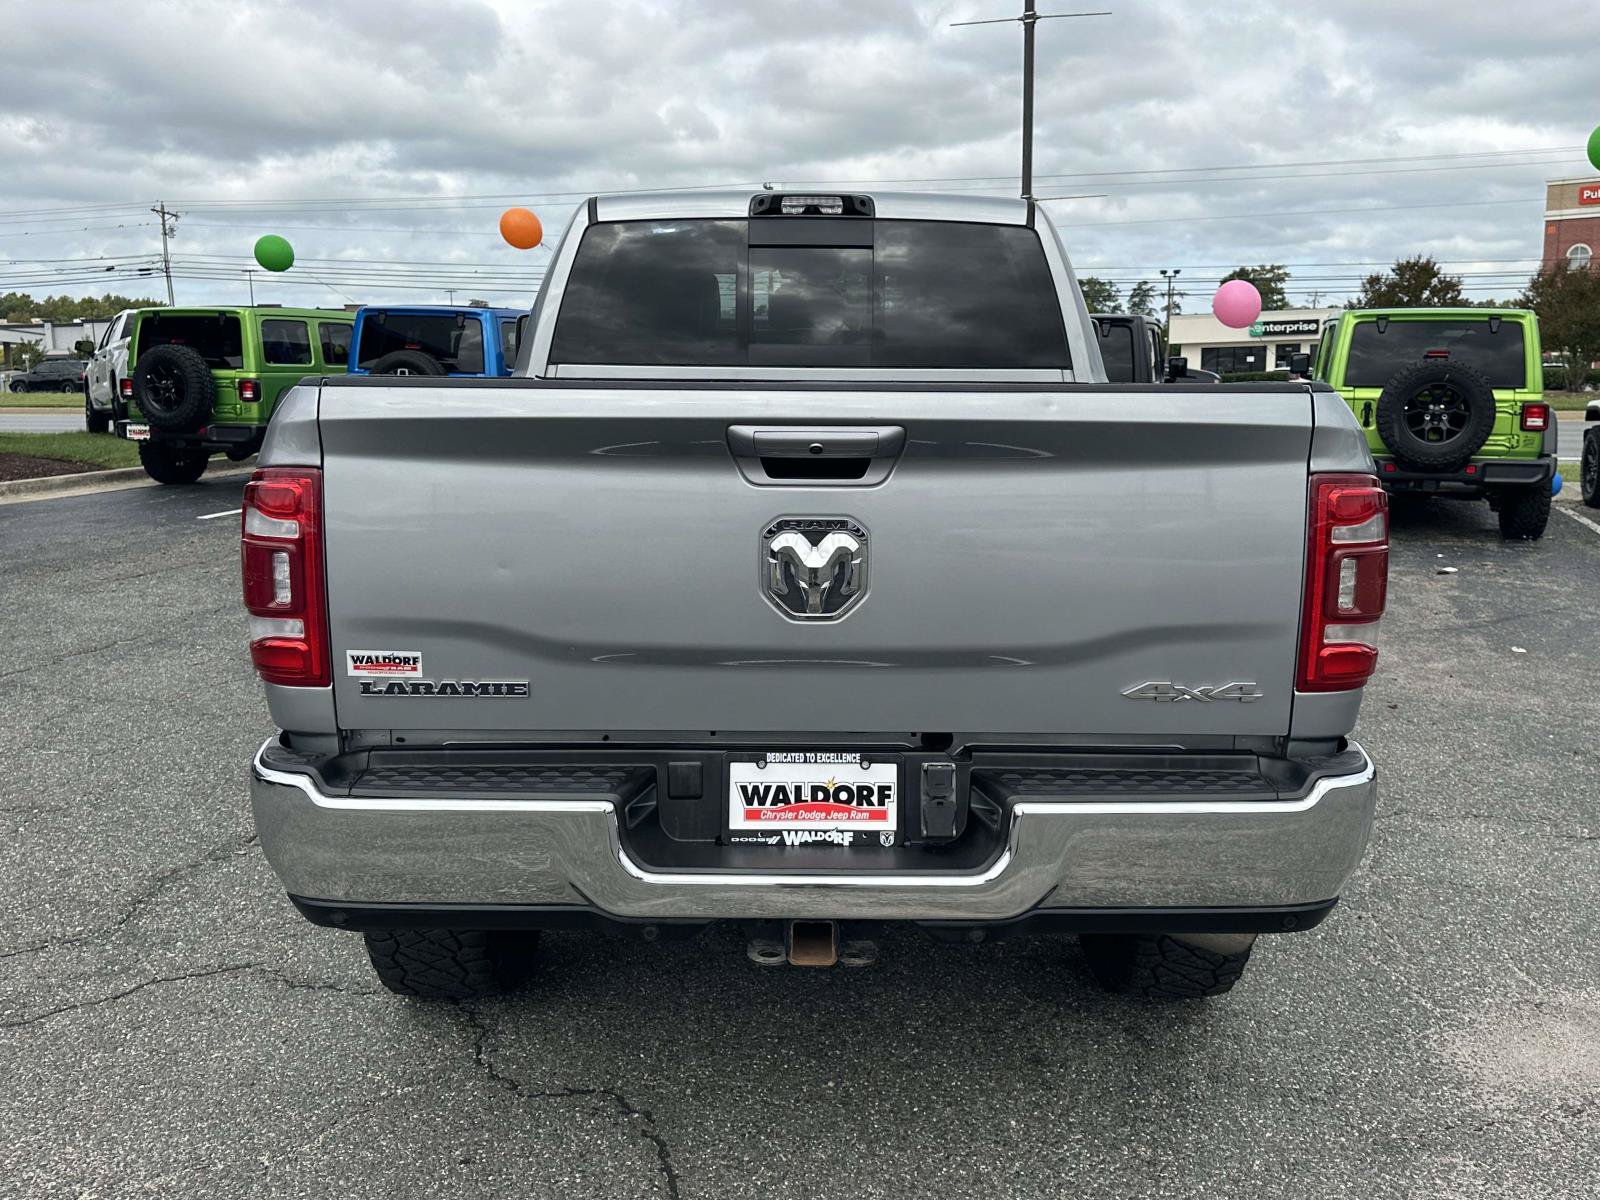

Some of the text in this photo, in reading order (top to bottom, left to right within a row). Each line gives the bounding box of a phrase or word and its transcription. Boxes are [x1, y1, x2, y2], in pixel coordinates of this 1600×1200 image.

[1254, 322, 1317, 333] enterprise
[783, 520, 847, 530] RAM
[350, 655, 420, 665] WALDORF
[358, 680, 530, 697] LARAMIE
[766, 752, 861, 763] DEDICATED TO EXCELLENCE
[739, 784, 892, 807] WALDORF
[760, 809, 870, 821] Chrysler Dodge Jeep Ram
[782, 830, 854, 846] WALDORF
